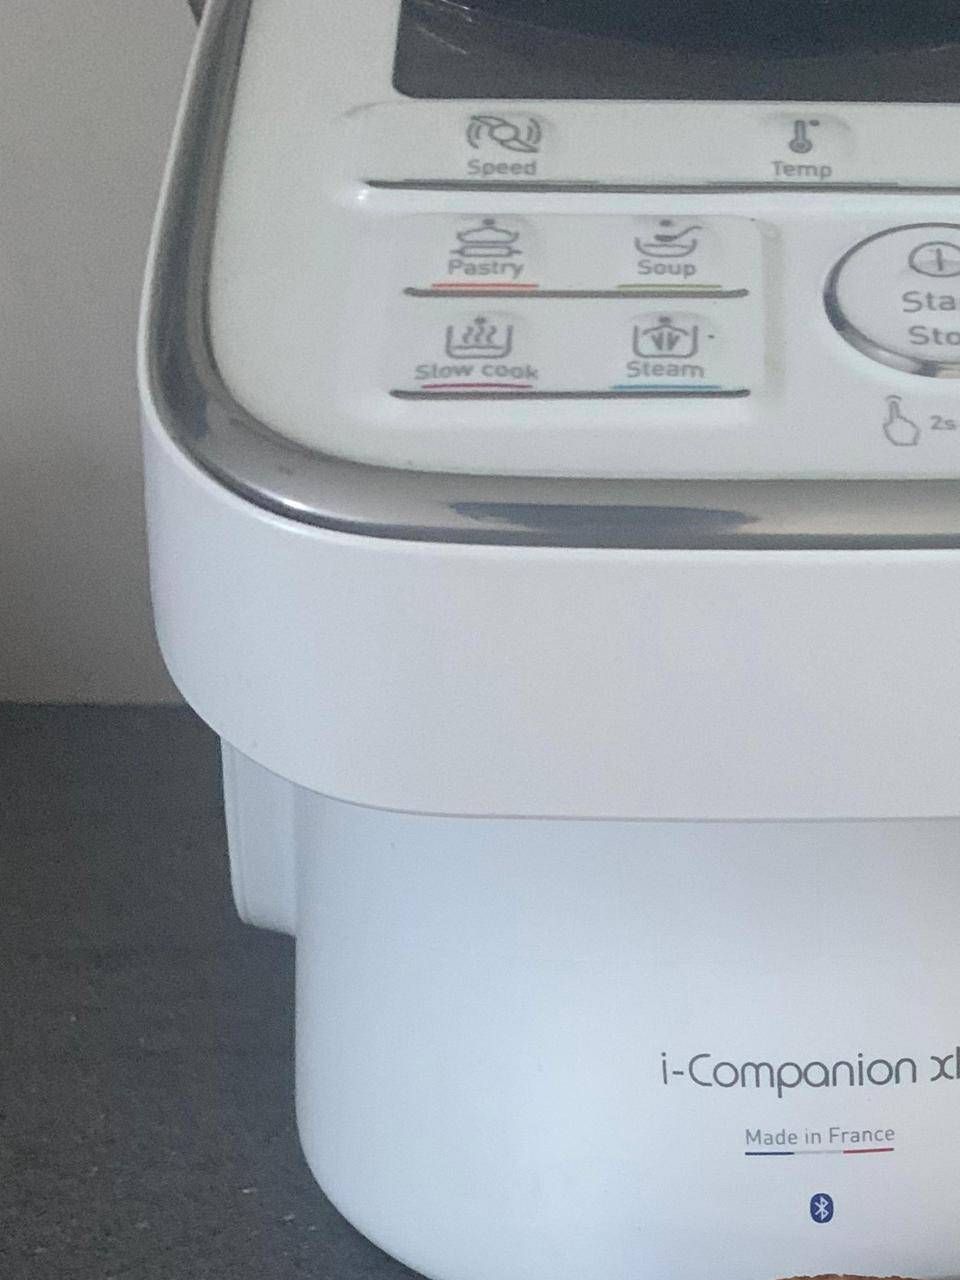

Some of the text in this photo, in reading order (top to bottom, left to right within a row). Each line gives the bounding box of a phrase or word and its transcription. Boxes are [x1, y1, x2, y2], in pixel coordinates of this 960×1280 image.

[467, 158, 537, 177] Speed
[771, 161, 832, 179] Temp
[448, 259, 524, 277] Pastry
[637, 259, 697, 277] Soup
[415, 363, 539, 381] Slow cook
[626, 361, 705, 378] Steam
[930, 416, 957, 431] 2s
[661, 1051, 918, 1099] i-Companion
[744, 1126, 896, 1146] Made in France
